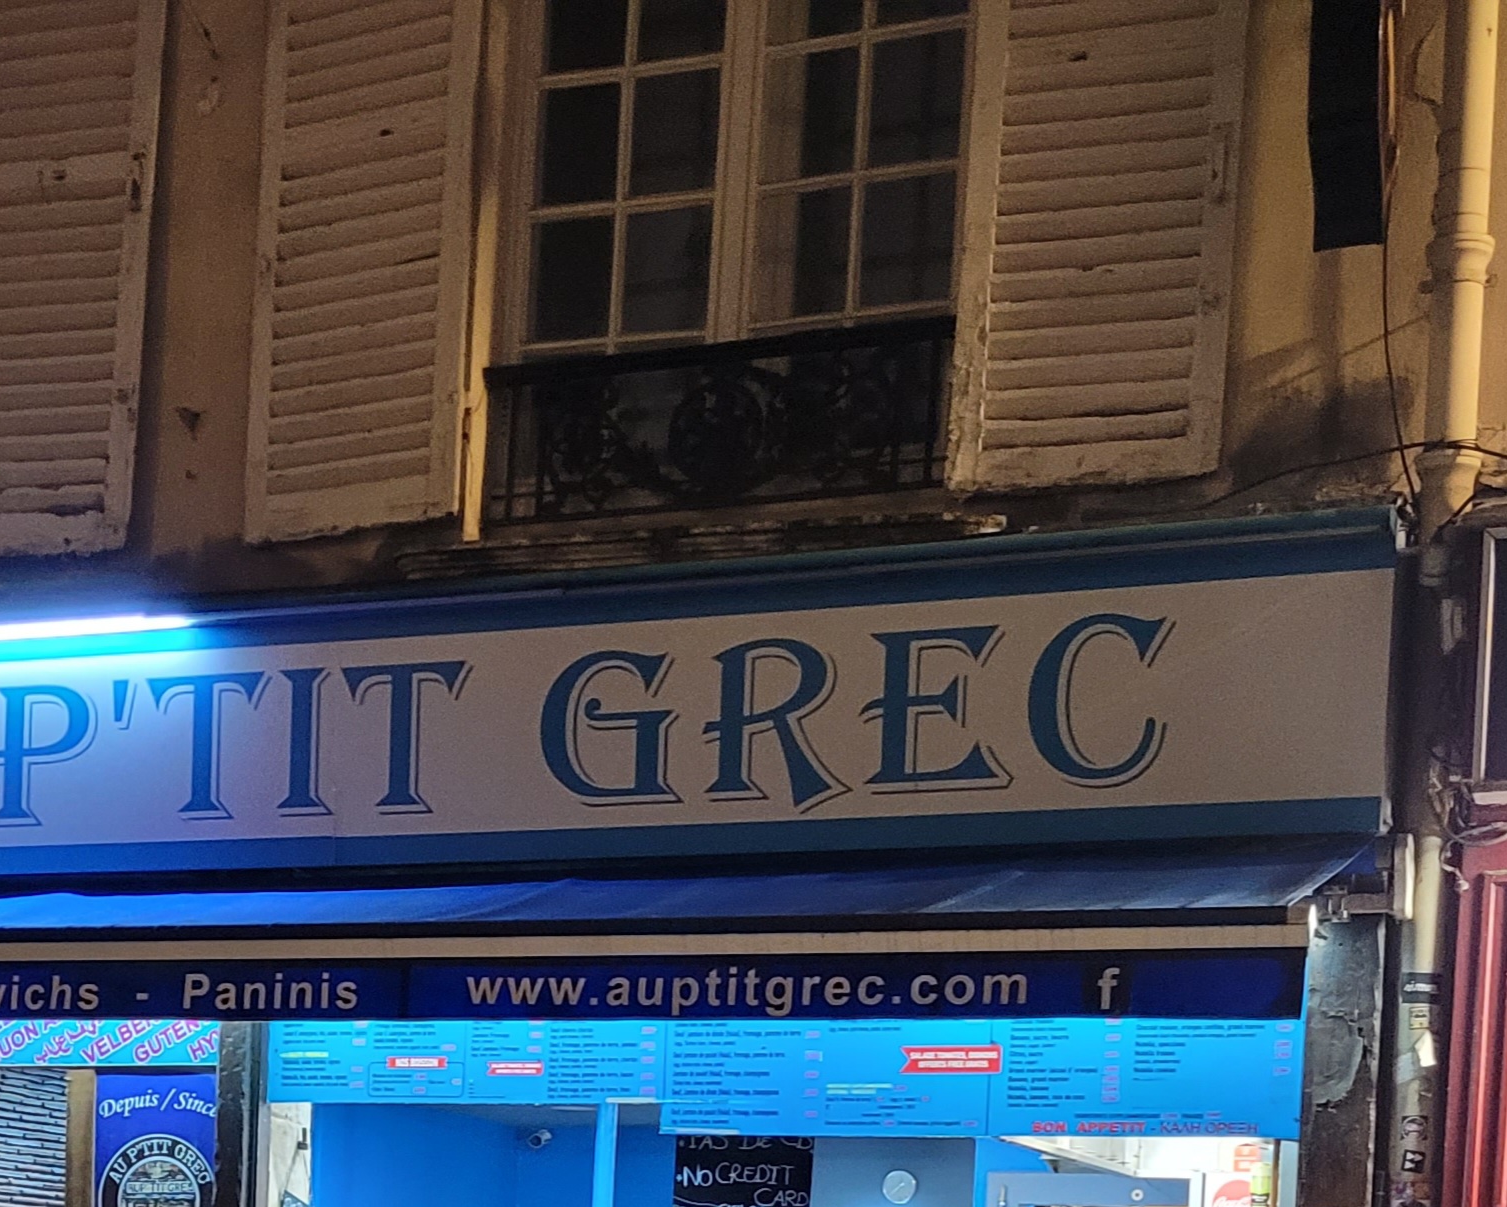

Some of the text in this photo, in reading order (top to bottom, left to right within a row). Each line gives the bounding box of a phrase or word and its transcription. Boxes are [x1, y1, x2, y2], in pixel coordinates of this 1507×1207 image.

[539, 610, 1177, 816] GREC
[182, 972, 359, 1009] Paninis
[467, 968, 1029, 1017] www.auptitgrec.com
[99, 1090, 160, 1118] Depuis
[1032, 1120, 1067, 1133] BON
[1077, 1120, 1146, 1134] APPETIT
[173, 1144, 212, 1184] GREC
[715, 1161, 795, 1186] CREDIT
[753, 1187, 810, 1207] CARD
